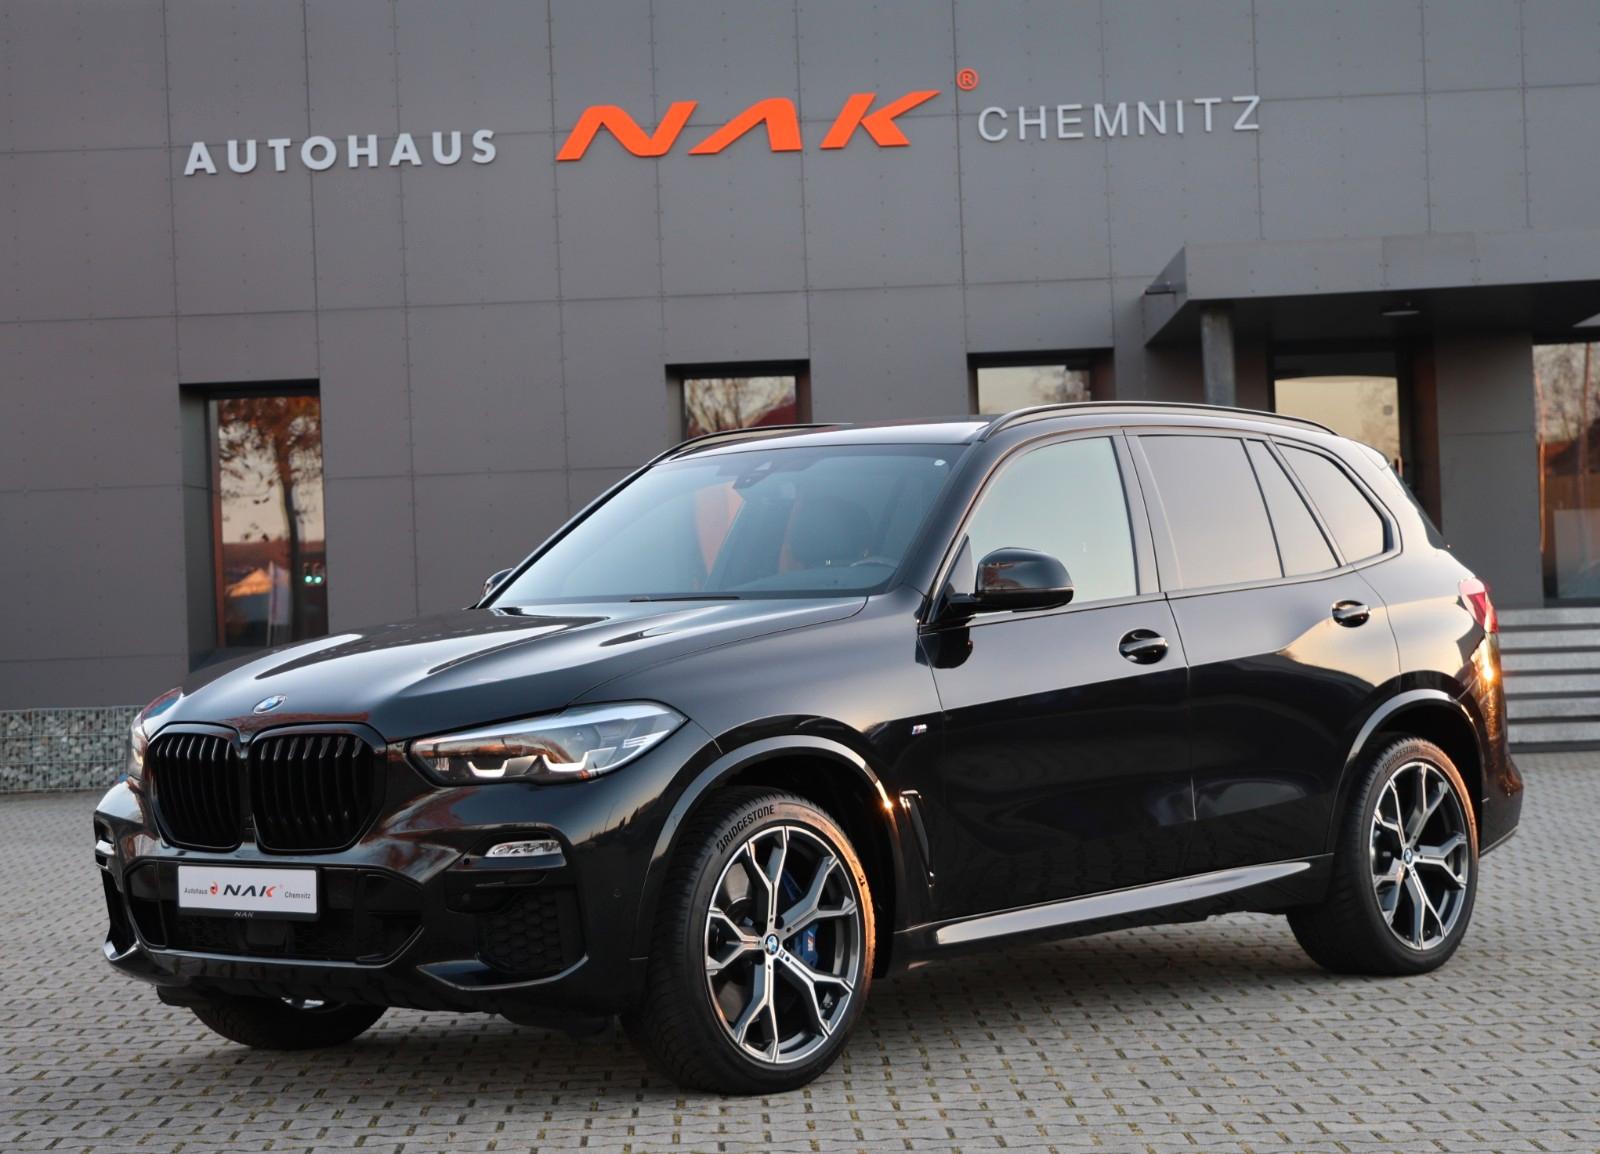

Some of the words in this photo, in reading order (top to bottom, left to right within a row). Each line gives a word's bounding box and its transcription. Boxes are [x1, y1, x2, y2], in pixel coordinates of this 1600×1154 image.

[184, 129, 497, 175] AUTOHAUS
[555, 90, 940, 162] NAK
[977, 95, 1261, 142] CHEMNITZ
[715, 803, 776, 855] BRIDGESTONE
[223, 884, 277, 898] NAK
[284, 890, 312, 900] Chemnitz
